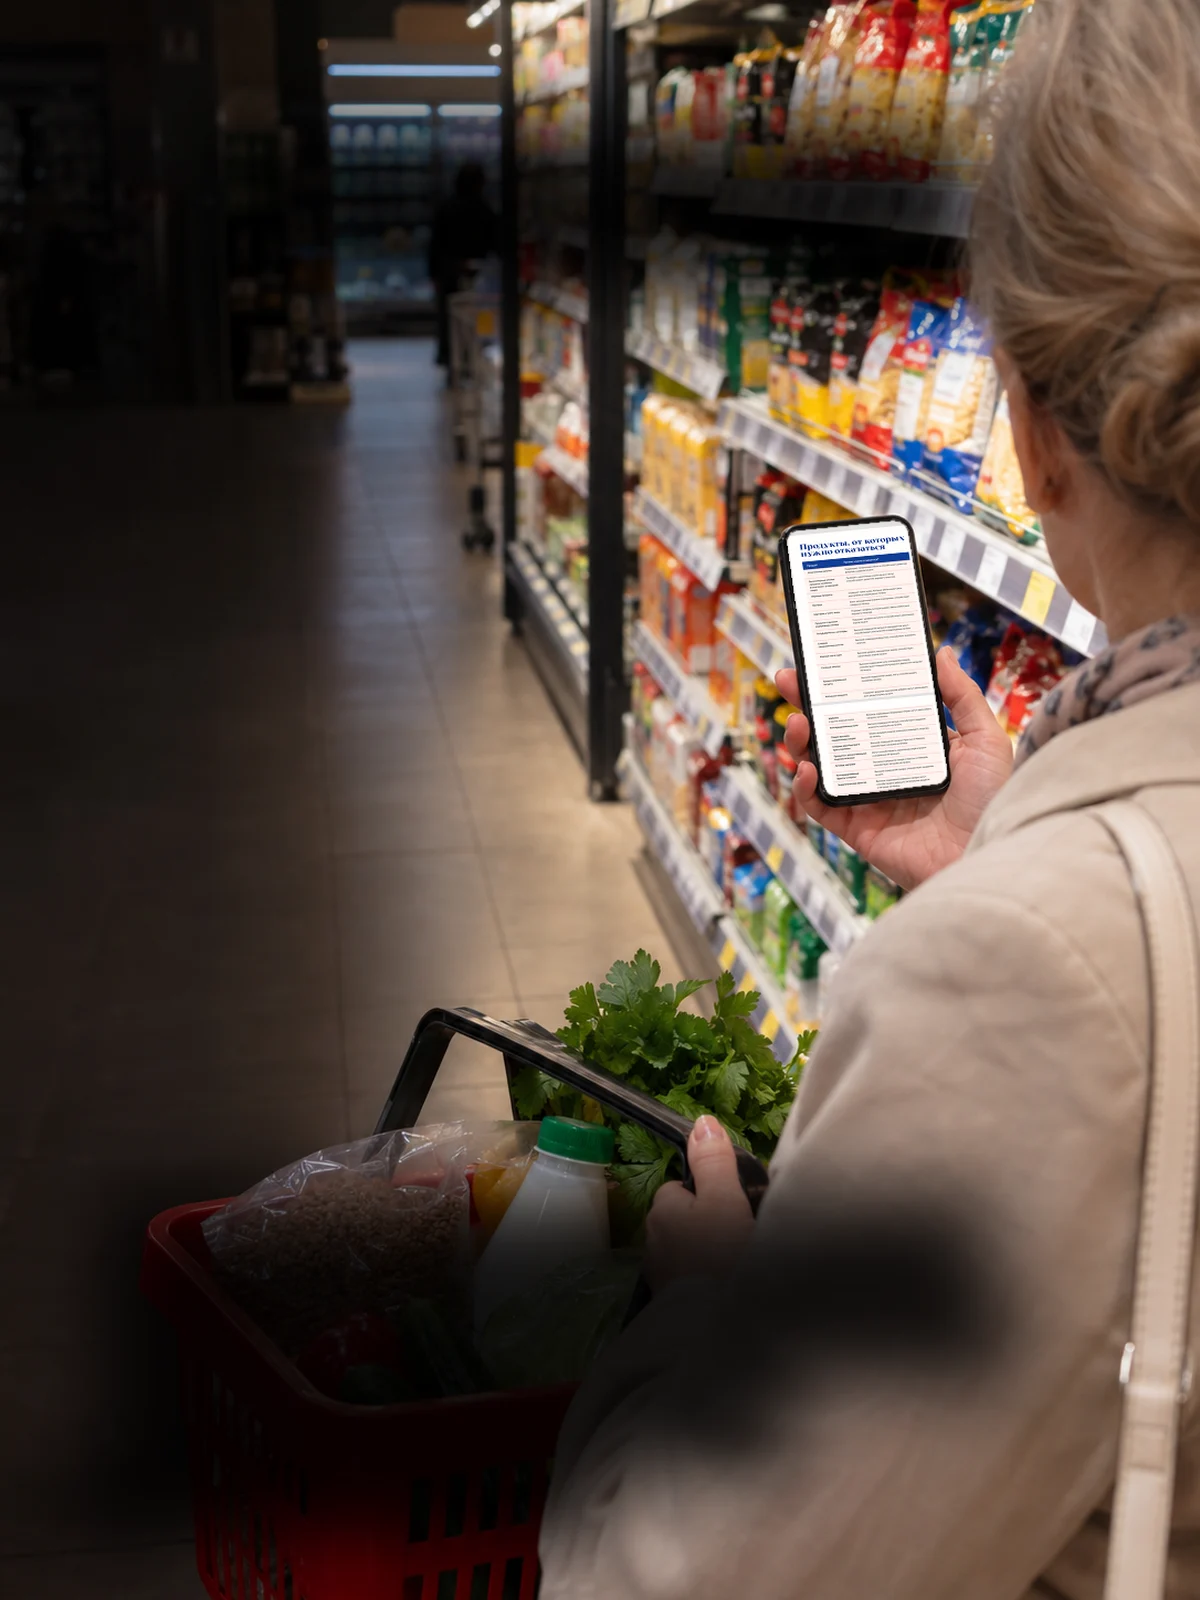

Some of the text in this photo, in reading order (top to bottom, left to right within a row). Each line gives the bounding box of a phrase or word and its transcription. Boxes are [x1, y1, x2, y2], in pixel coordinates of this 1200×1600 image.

[865, 536, 905, 545] которых
[801, 545, 885, 558] нужно отказаться
